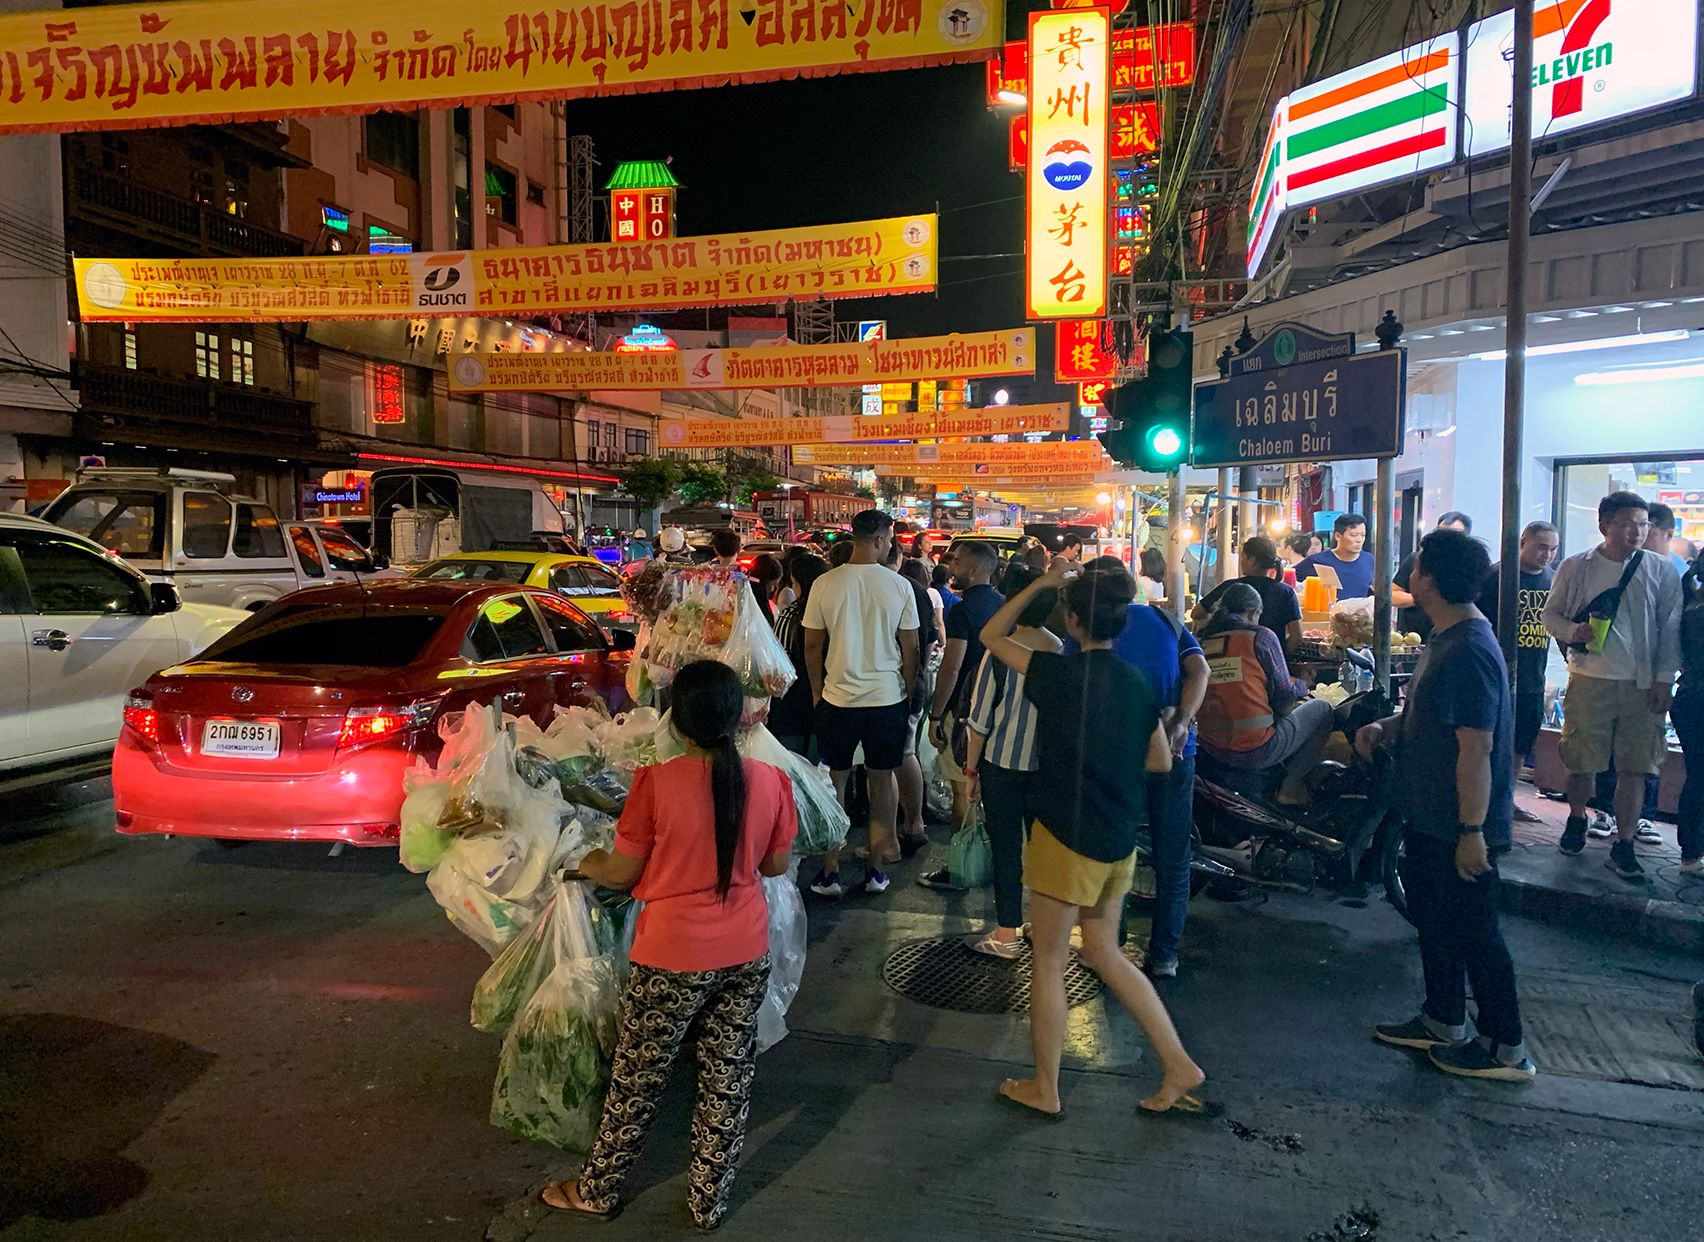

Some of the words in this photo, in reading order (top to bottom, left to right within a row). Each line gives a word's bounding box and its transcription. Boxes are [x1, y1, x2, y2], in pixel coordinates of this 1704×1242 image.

[371, 29, 457, 81] จำกัด
[483, 241, 698, 282] ธนาคารธนชาต
[1047, 202, 1087, 303] 茅台
[279, 262, 298, 281] 28
[389, 258, 409, 276] 62
[418, 292, 467, 306] ธนชาต
[1298, 342, 1348, 362] Intersection
[1242, 355, 1262, 373] แยก
[1235, 368, 1338, 432] เฉลิมบุรี
[1239, 438, 1294, 457] Chaloem
[1301, 432, 1332, 452] Buri
[316, 492, 345, 502] Chinatown
[346, 491, 361, 501] Hotel
[1518, 636, 1548, 649] SOON
[240, 726, 273, 741] 6951
